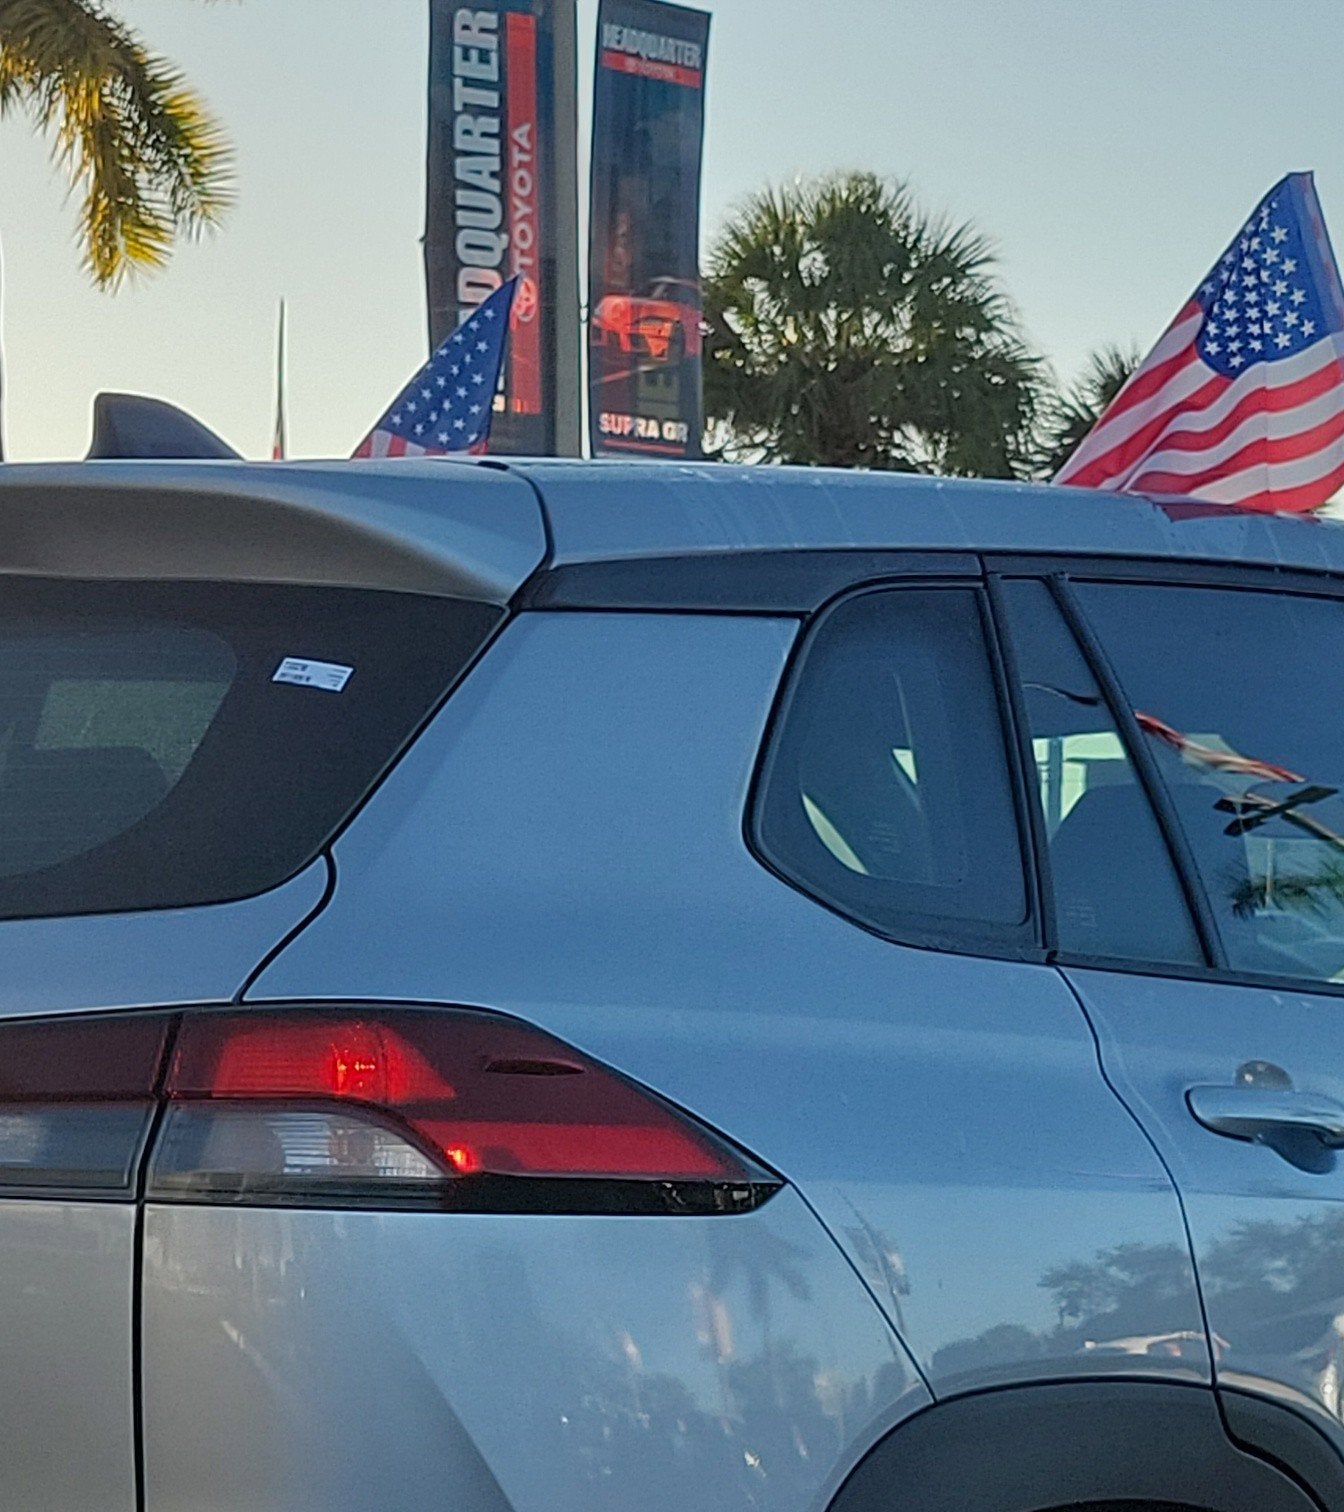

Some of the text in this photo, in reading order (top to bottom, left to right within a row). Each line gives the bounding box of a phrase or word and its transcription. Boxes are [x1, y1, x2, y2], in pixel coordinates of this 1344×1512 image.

[601, 23, 702, 68] HEADQUARTER
[454, 8, 509, 325] DQUARTER
[511, 123, 533, 274] TOYOTA
[599, 412, 688, 444] SUPRA GR
